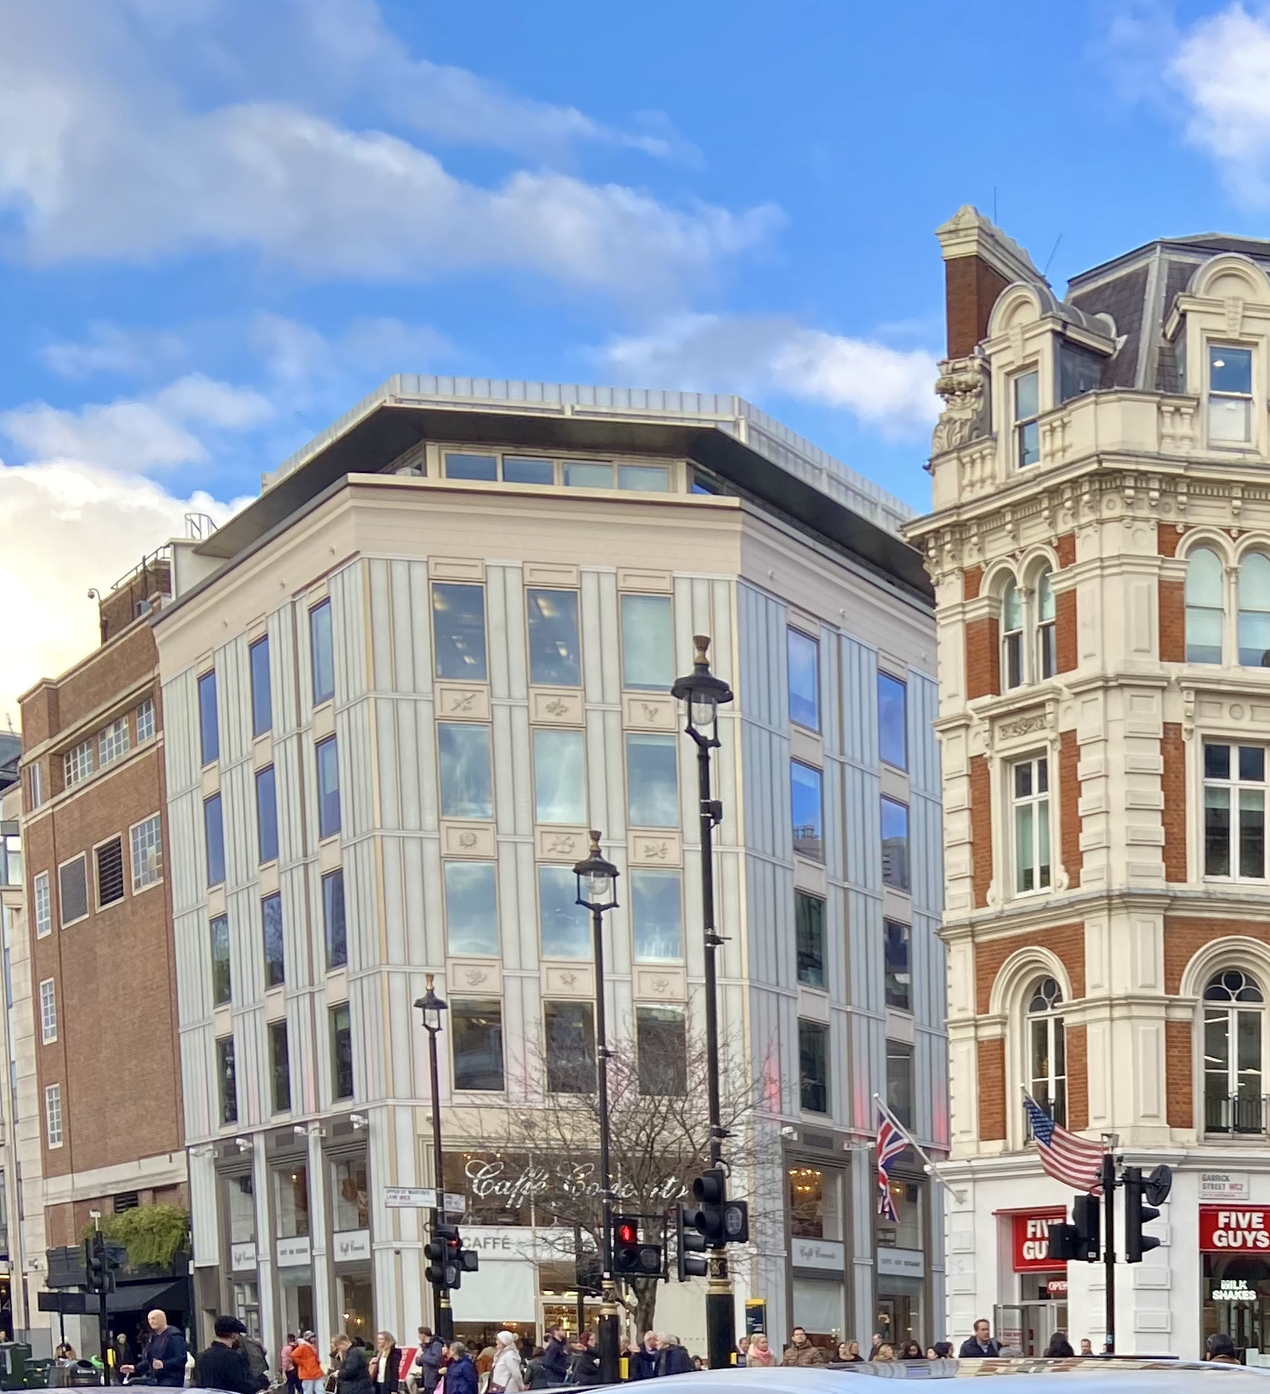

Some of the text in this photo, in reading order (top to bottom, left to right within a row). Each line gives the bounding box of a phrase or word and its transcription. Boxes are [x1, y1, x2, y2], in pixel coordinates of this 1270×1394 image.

[1229, 1183, 1244, 1191] WC2
[1026, 1218, 1064, 1239] FIV
[1217, 1211, 1265, 1229] FIVE
[462, 1234, 511, 1250] CAFFÉ
[1212, 1229, 1270, 1248] GUYS
[1022, 1240, 1050, 1261] GU
[1220, 1279, 1248, 1290] MILK
[1212, 1290, 1257, 1301] SHAKES
